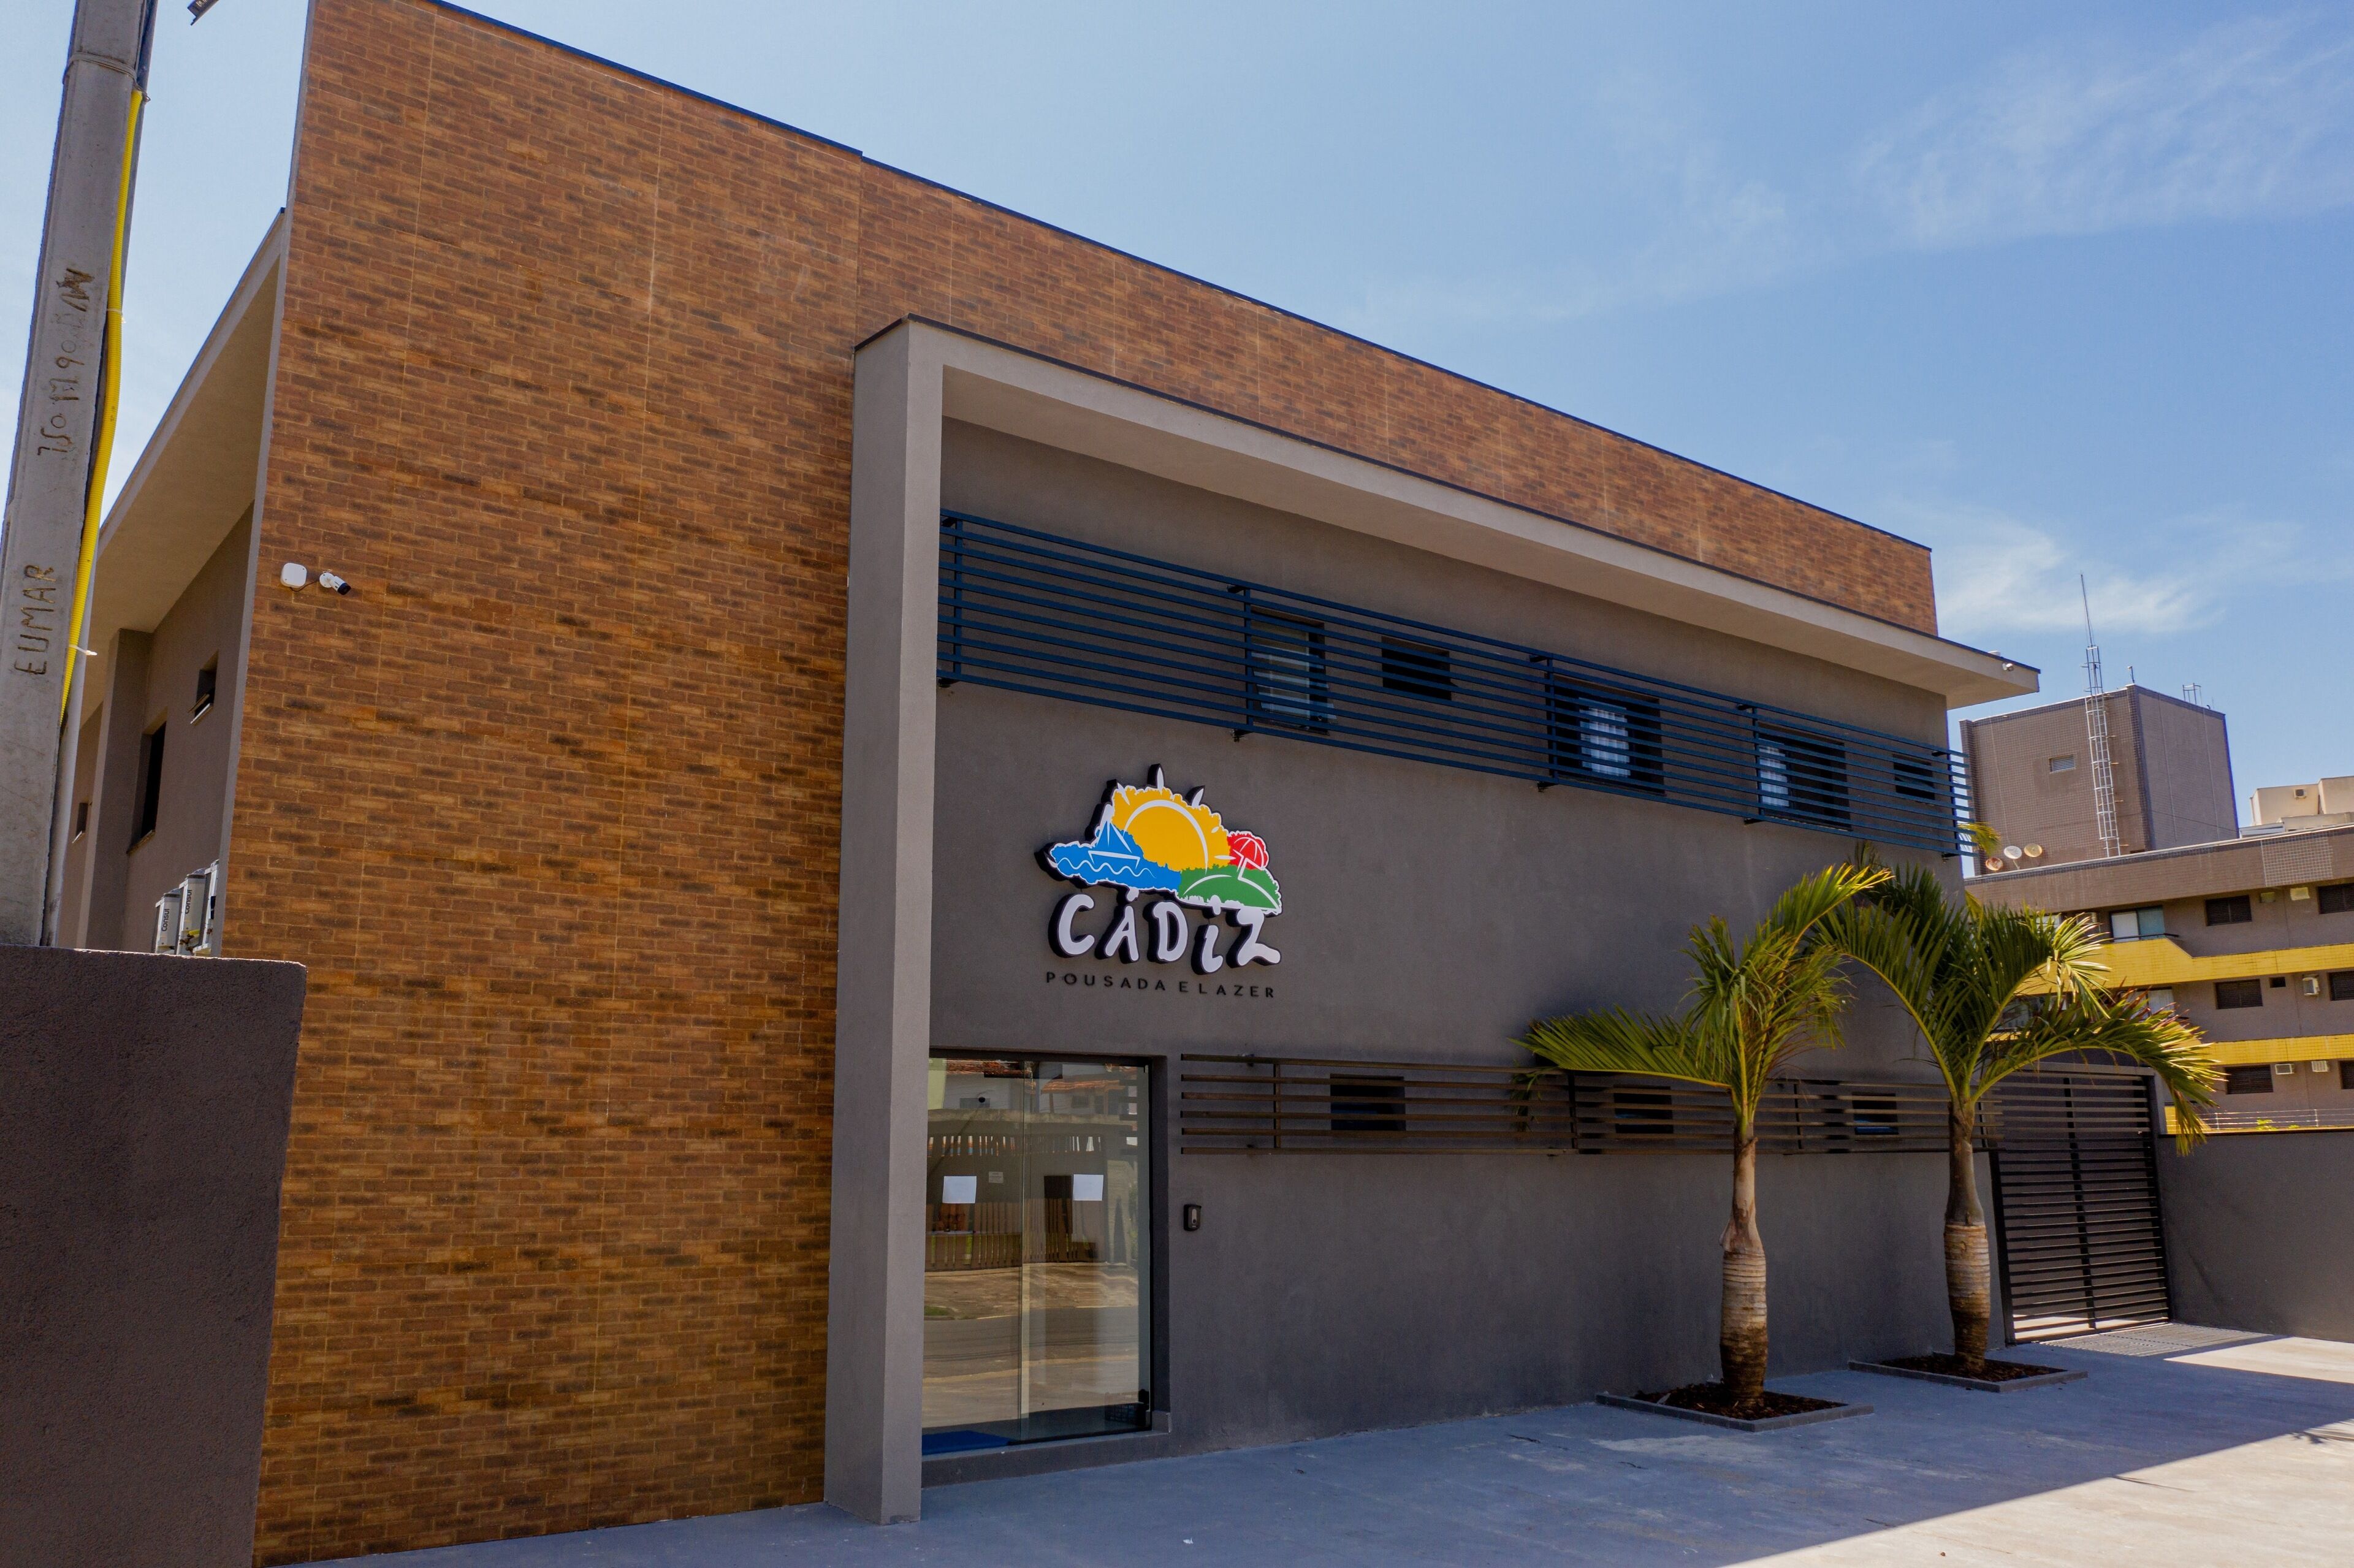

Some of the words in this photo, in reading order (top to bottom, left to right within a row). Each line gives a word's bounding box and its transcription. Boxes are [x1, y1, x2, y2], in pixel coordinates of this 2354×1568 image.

[14, 565, 56, 674] EUMAR
[161, 908, 170, 931] Consul
[1046, 972, 1166, 991] POUSADA
